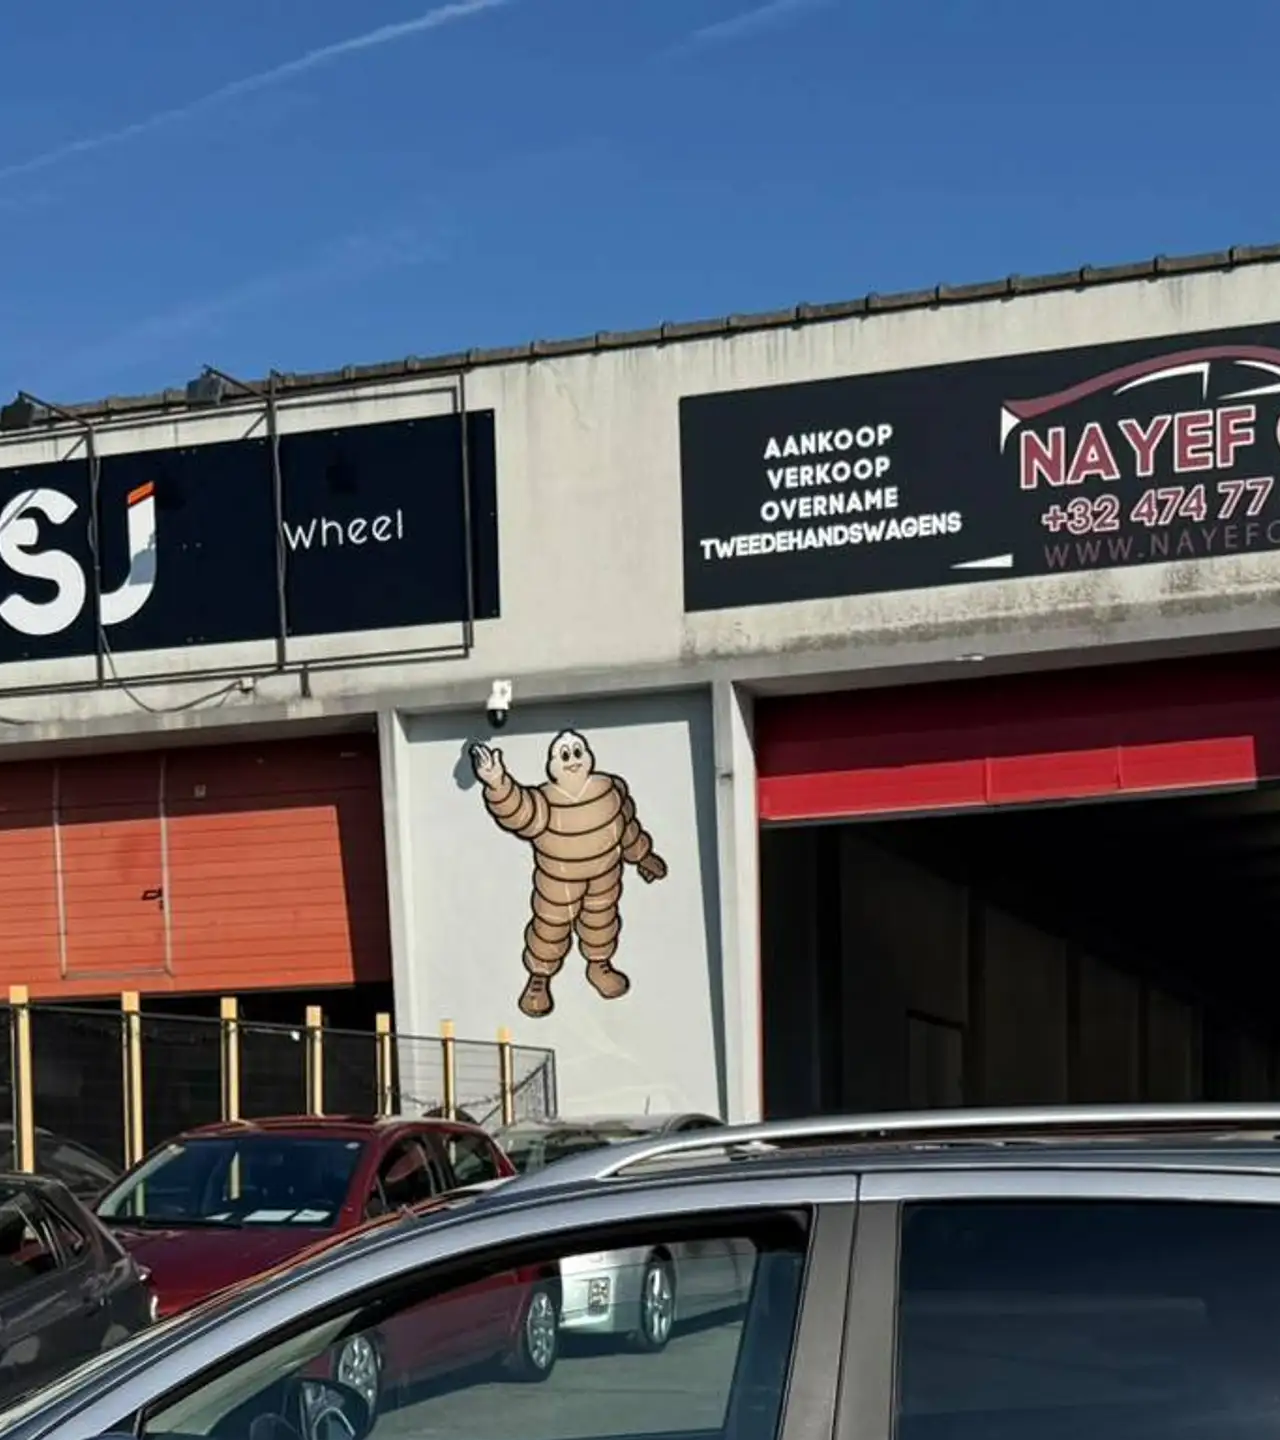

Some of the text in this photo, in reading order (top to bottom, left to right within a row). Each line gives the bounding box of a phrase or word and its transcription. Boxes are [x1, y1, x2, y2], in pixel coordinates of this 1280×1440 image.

[763, 423, 893, 460] AANKOOP
[1019, 404, 1257, 490] NAYEF
[767, 456, 890, 490] VERKOOP
[760, 486, 899, 522] OVERNAME
[1041, 493, 1121, 535] +32
[1130, 481, 1208, 528] 474
[1217, 475, 1275, 520] 77
[699, 511, 963, 560] TWEEDEHANDSWAGENS
